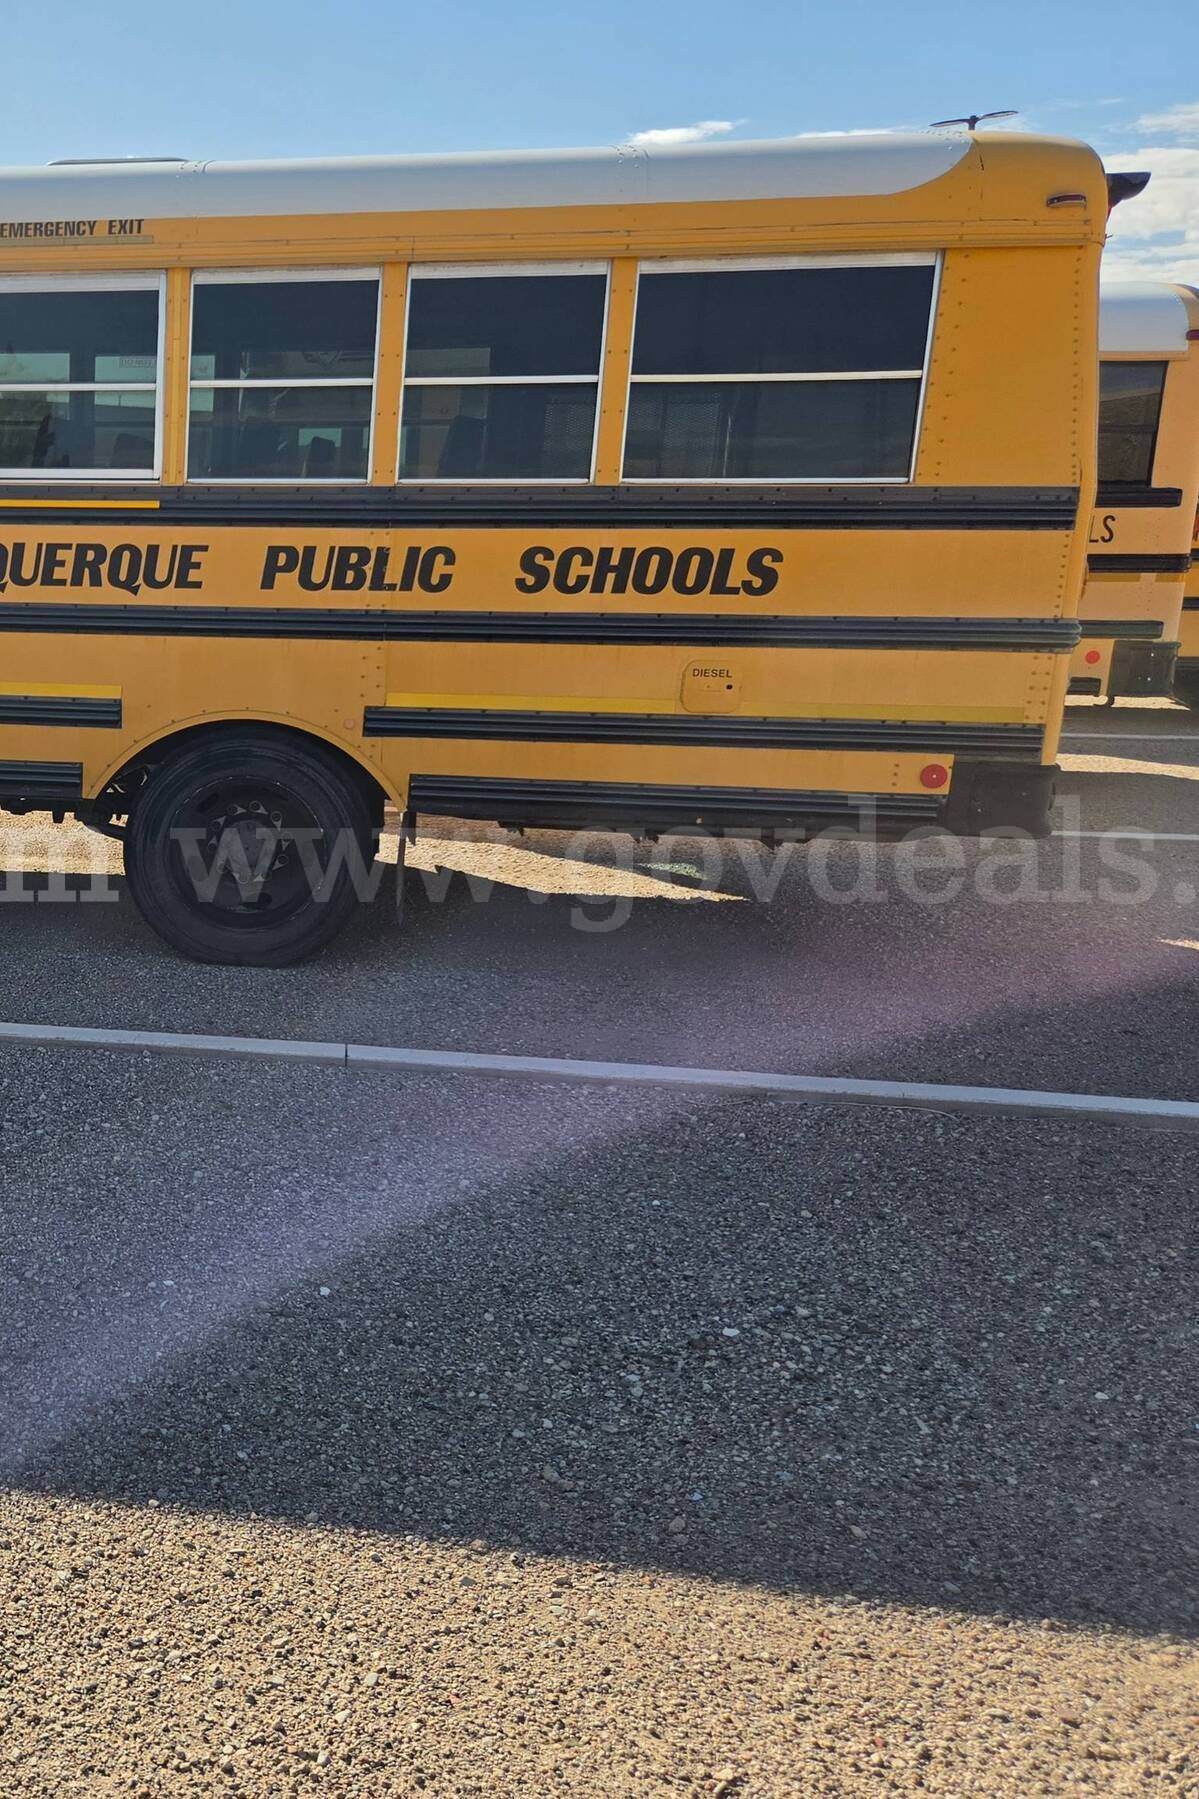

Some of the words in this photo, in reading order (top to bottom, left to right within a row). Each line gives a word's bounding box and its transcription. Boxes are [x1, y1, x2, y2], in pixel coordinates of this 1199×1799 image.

[0, 220, 97, 238] EMERGENCY
[107, 219, 145, 236] EXIT
[260, 545, 457, 592] PUBLIC
[515, 546, 784, 597] SCHOOLS
[692, 668, 733, 678] DIESEL
